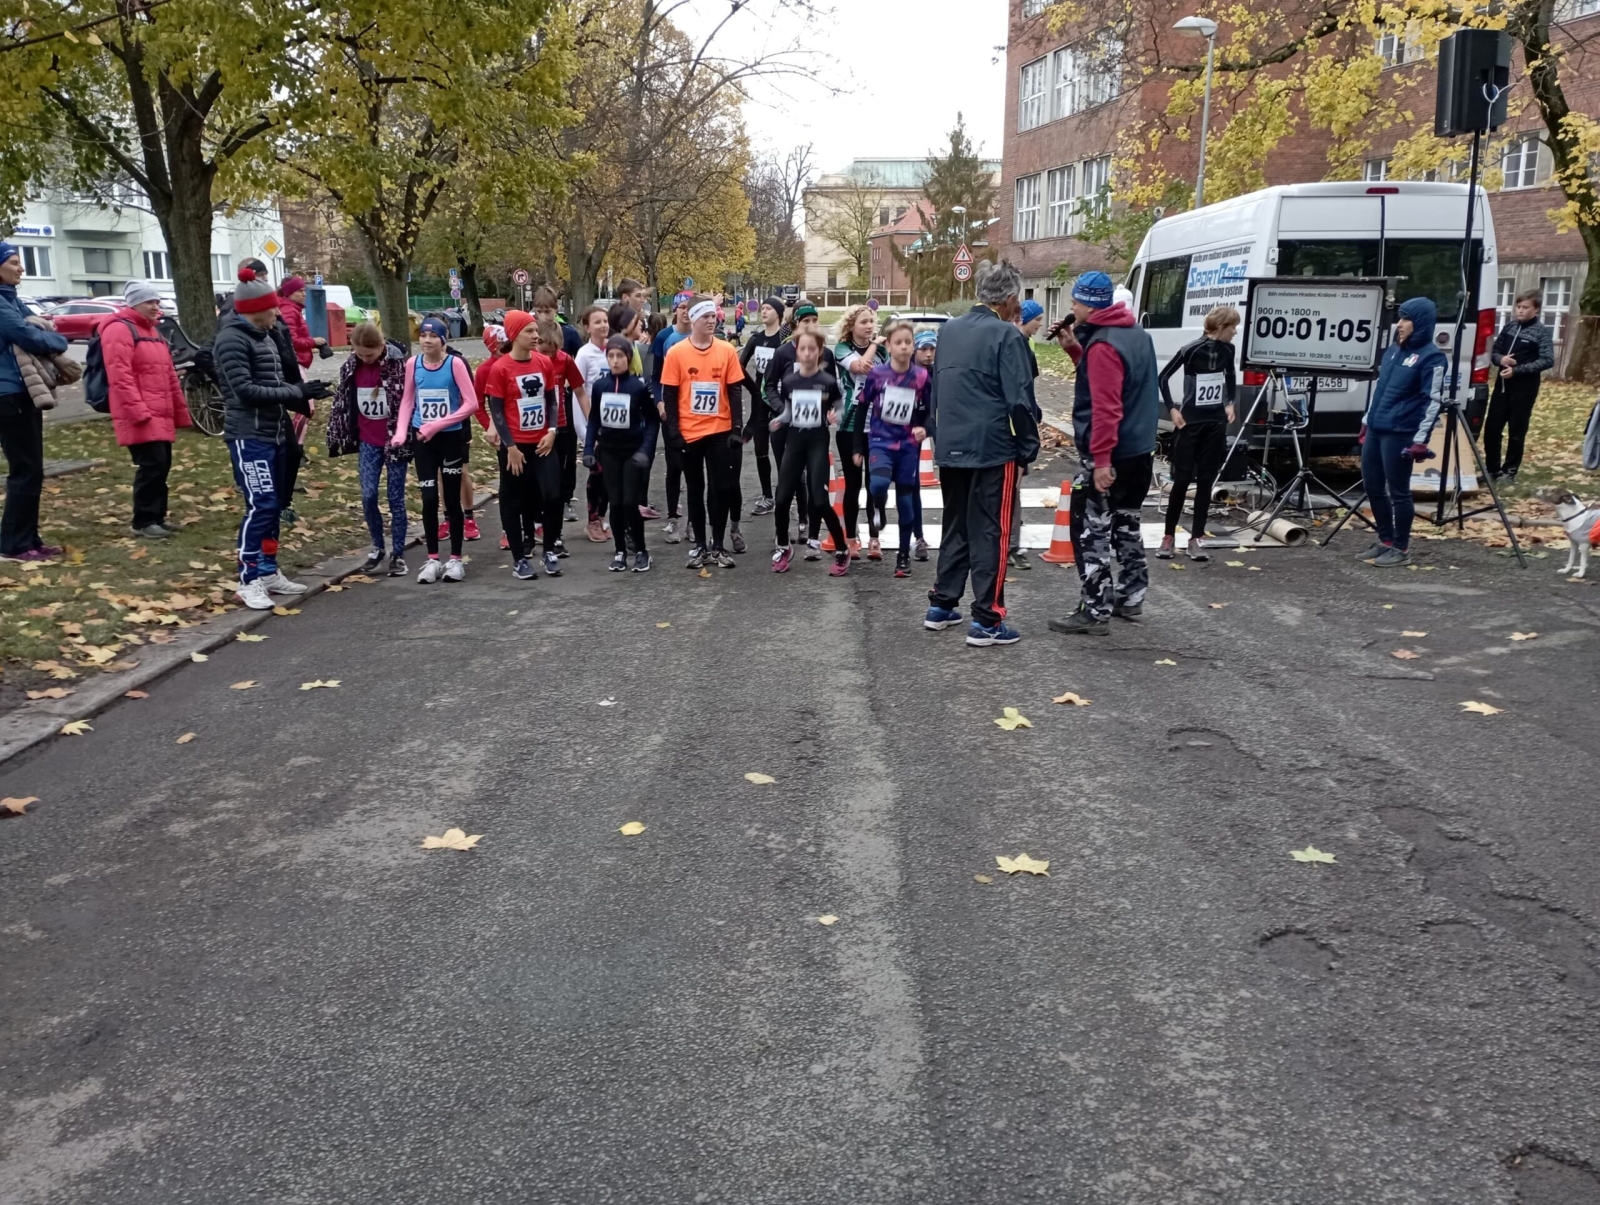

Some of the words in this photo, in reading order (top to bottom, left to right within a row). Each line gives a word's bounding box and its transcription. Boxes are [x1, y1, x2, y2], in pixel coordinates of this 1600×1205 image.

[1186, 288, 1208, 300] innovative
[1209, 286, 1224, 298] timing
[1224, 285, 1243, 298] system
[1258, 307, 1274, 315] 900
[1291, 308, 1311, 316] 1800
[1256, 316, 1372, 343] 00:01:05
[1318, 378, 1342, 388] 5458
[1198, 384, 1222, 401] 202
[362, 401, 384, 416] 221
[422, 402, 448, 418] 230
[694, 395, 716, 411] 219
[884, 401, 910, 420] 218
[522, 409, 544, 427] 226
[603, 408, 628, 424] 208
[243, 462, 262, 494] REPUBLIC
[254, 460, 274, 492] CZECH
